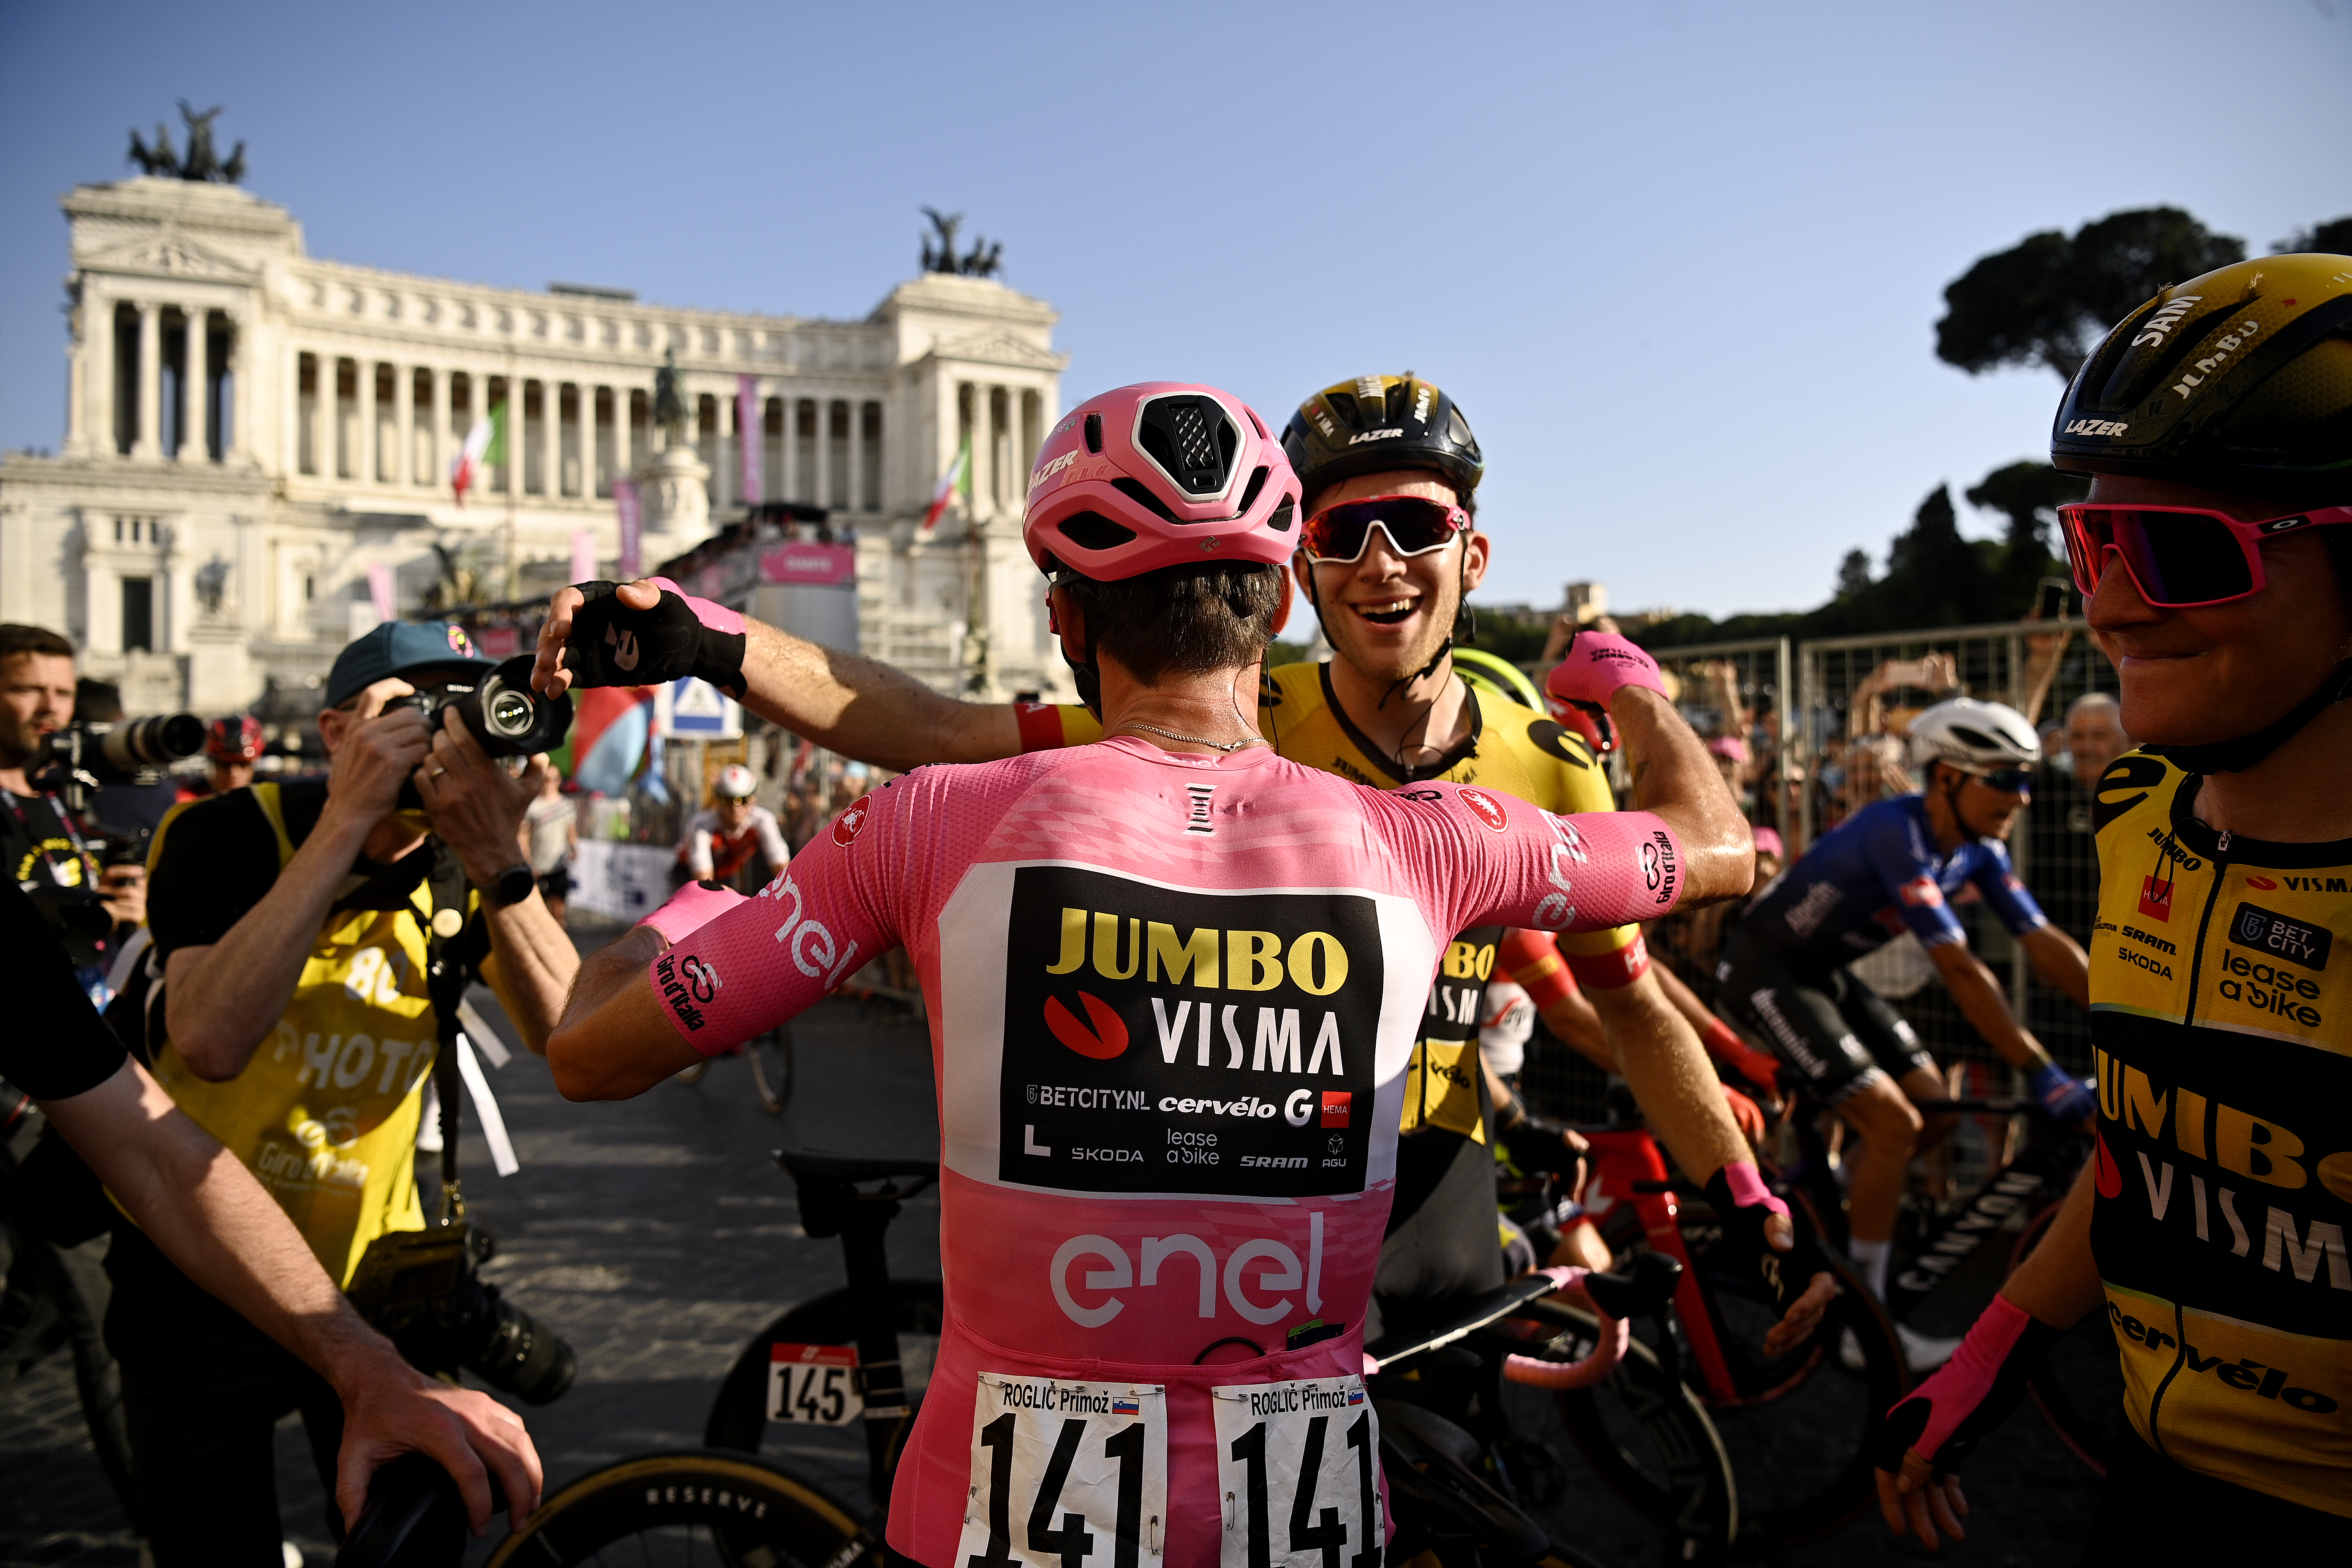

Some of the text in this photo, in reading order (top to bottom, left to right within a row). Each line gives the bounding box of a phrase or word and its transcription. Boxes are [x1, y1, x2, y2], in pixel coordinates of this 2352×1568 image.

[2132, 296, 2202, 347] SAM
[1348, 428, 1404, 445] LAZER
[2064, 420, 2128, 437] LAZER
[1164, 755, 1220, 768] enel
[2147, 828, 2202, 871] JUMBO
[2143, 890, 2168, 906] HEMA
[2283, 877, 2352, 893] VISM
[2268, 936, 2316, 959] CITY
[2272, 920, 2312, 943] BET
[1046, 908, 1348, 996] JUMBO
[2222, 949, 2320, 1000] lease
[1151, 997, 1343, 1076] VISMA
[1040, 1086, 1150, 1110] BETCITY.NL
[1159, 1096, 1276, 1118] cervélo
[1323, 1104, 1348, 1115] HEMA
[1167, 1129, 1217, 1146] lease
[1240, 1156, 1308, 1168] SRAM
[1322, 1158, 1346, 1168] AGU
[1897, 1172, 2044, 1292] CANYON
[1050, 1212, 1323, 1328] enel
[2109, 1300, 2338, 1414] cervélo
[775, 1366, 845, 1421] 145
[1003, 1381, 1109, 1414] ROGLIČ Primož
[1251, 1383, 1346, 1416] ROGLIČ Primož
[645, 1485, 768, 1520] RESERVE
[968, 1412, 1146, 1568] 141
[1231, 1409, 1383, 1568] 141
